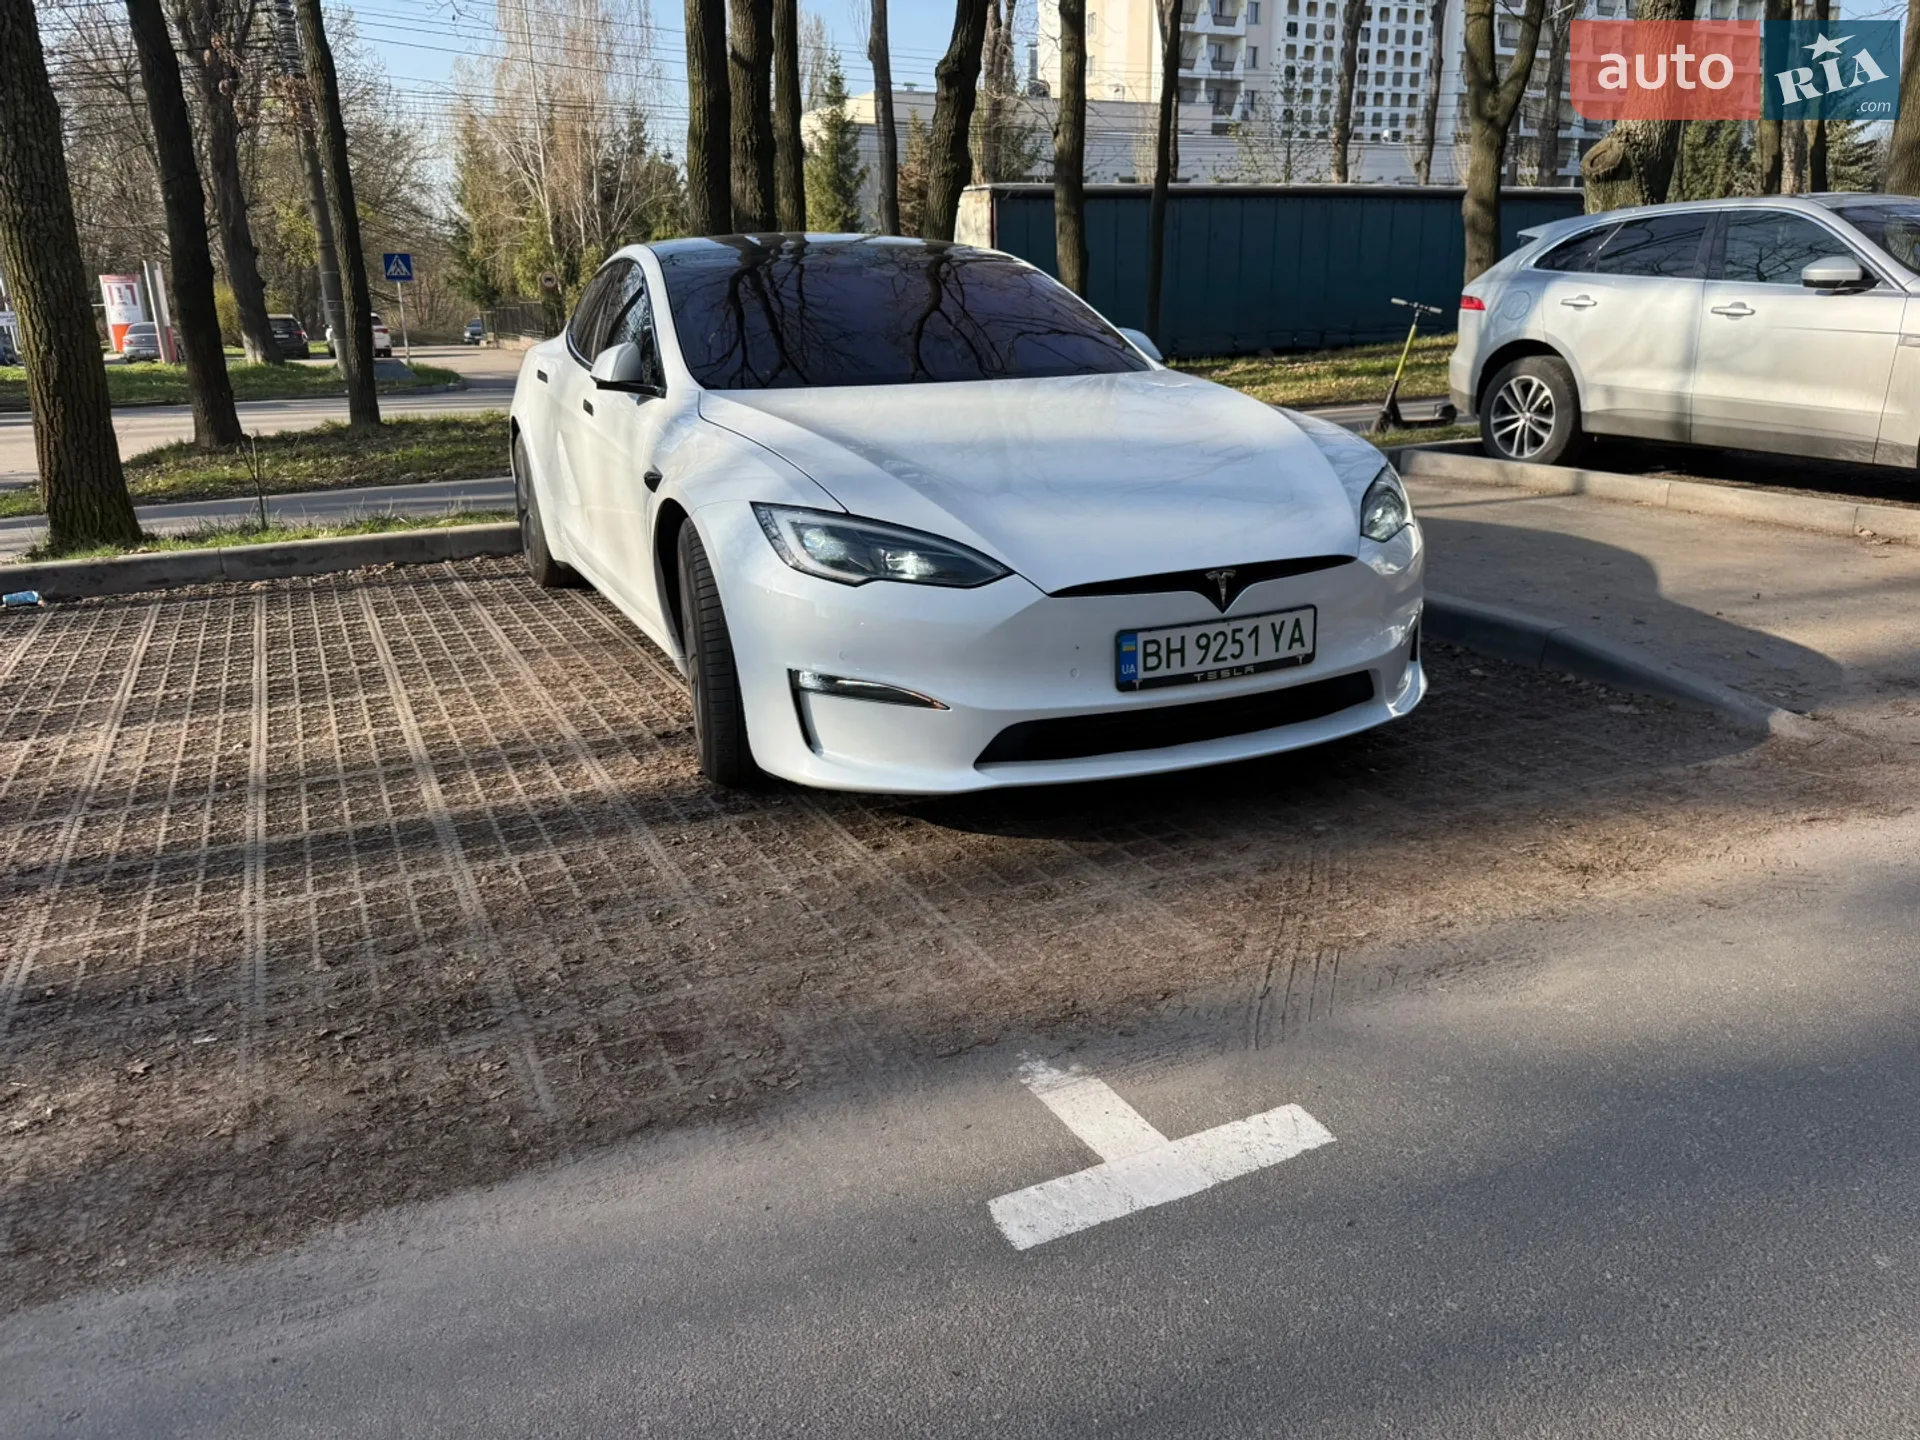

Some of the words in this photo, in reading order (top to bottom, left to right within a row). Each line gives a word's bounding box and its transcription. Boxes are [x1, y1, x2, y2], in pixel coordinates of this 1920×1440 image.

[1142, 636, 1186, 671] BH
[1195, 625, 1260, 665] 9251
[1271, 618, 1305, 652] YA
[1121, 664, 1136, 675] UA
[1194, 667, 1255, 681] TESLA
